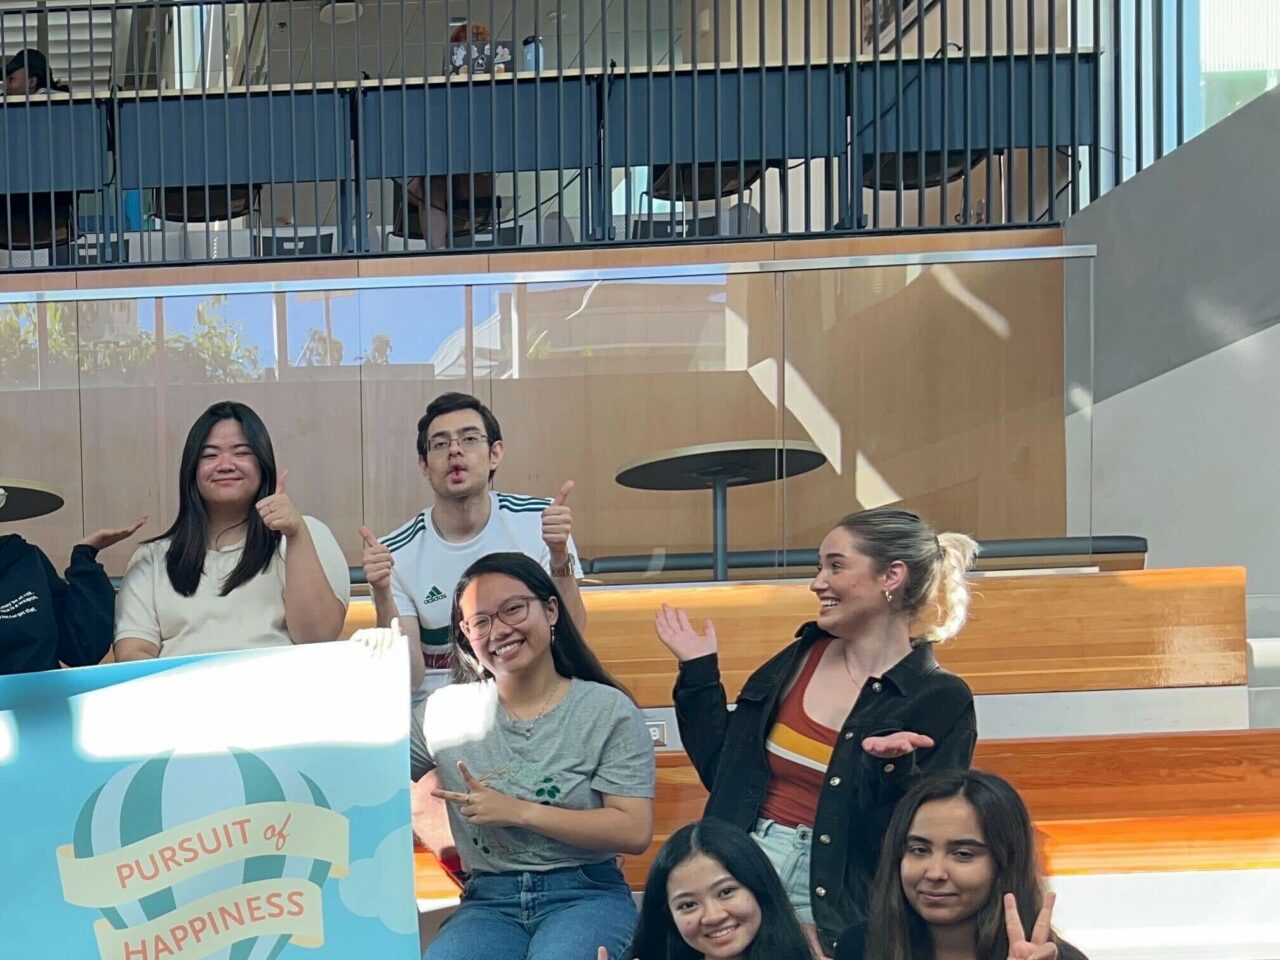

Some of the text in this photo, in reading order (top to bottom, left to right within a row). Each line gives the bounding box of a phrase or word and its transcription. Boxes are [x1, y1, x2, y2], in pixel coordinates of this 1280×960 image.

[423, 593, 448, 605] adidas
[115, 812, 292, 889] PURSUIT of
